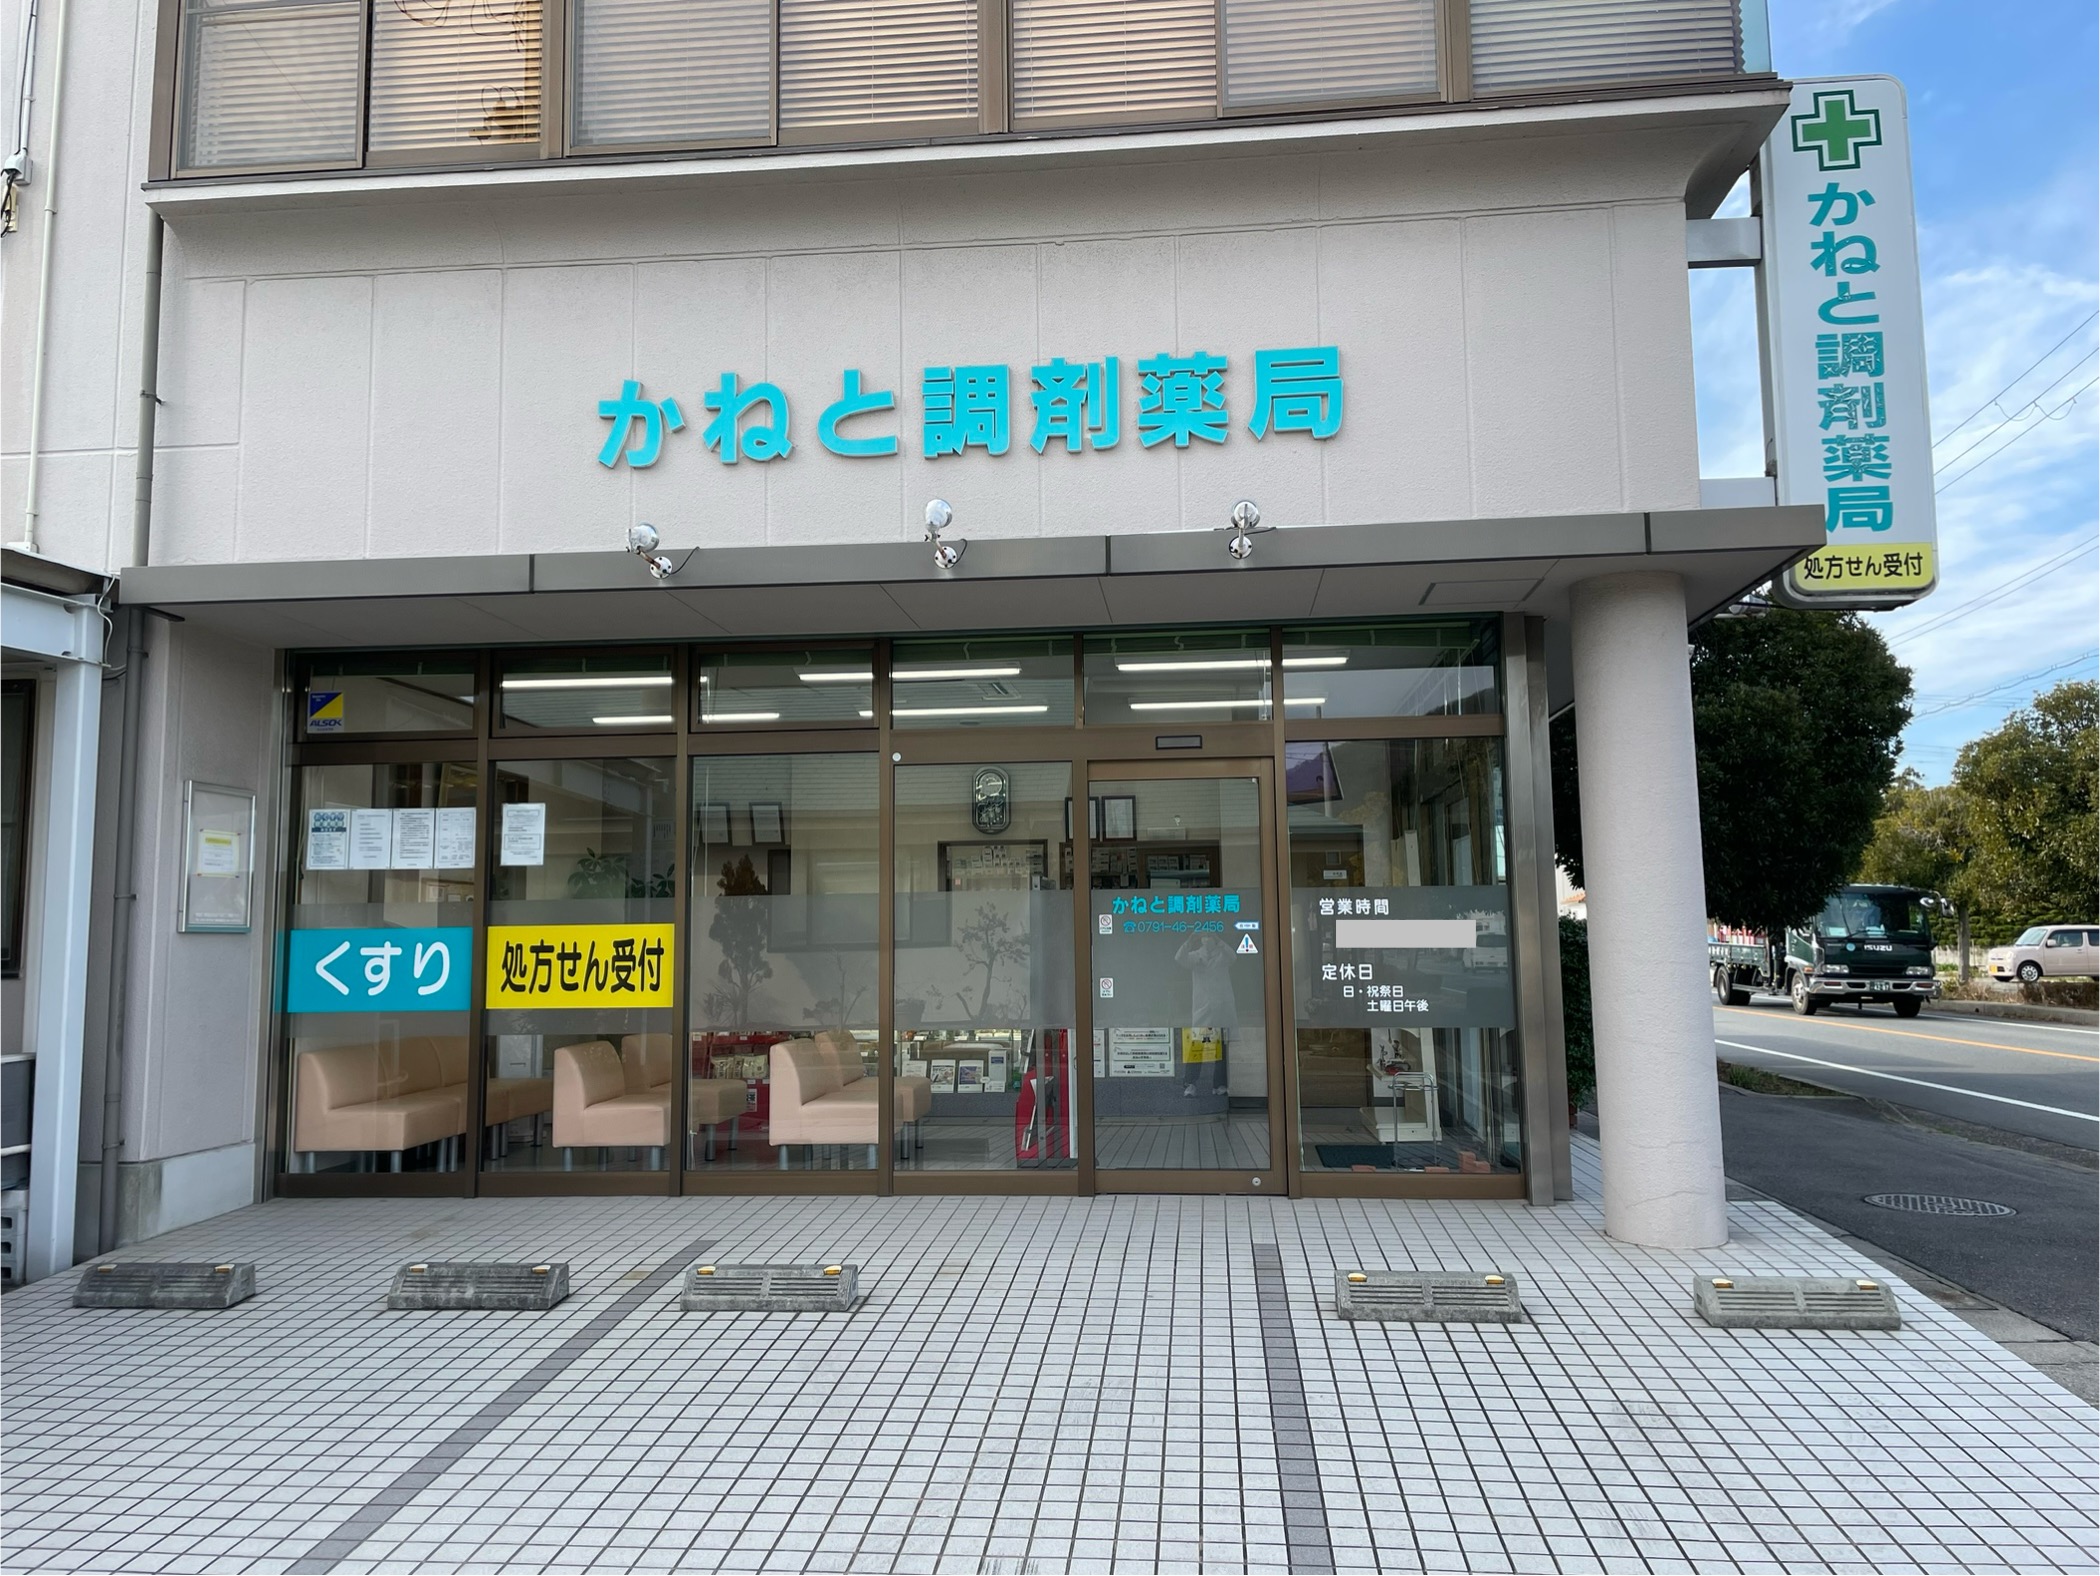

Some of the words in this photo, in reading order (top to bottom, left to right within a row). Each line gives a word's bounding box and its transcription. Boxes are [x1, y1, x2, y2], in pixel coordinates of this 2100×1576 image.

[1807, 182, 1894, 533] かねと調剤薬局
[598, 345, 1344, 469] かねと調剤薬局
[1804, 552, 1923, 580] 処方せん受付
[1112, 894, 1241, 914] かねと調剤薬局
[1319, 898, 1390, 915] 営業時間
[1137, 920, 1225, 933] 0791-46-2456
[1863, 944, 1893, 952] ISUZU
[315, 941, 450, 996] くすり
[500, 937, 665, 994] 処方せん受付
[1322, 963, 1374, 981] 定休日
[1343, 985, 1404, 998] 日・祝祭日
[1367, 999, 1429, 1012] 土曜日午後
